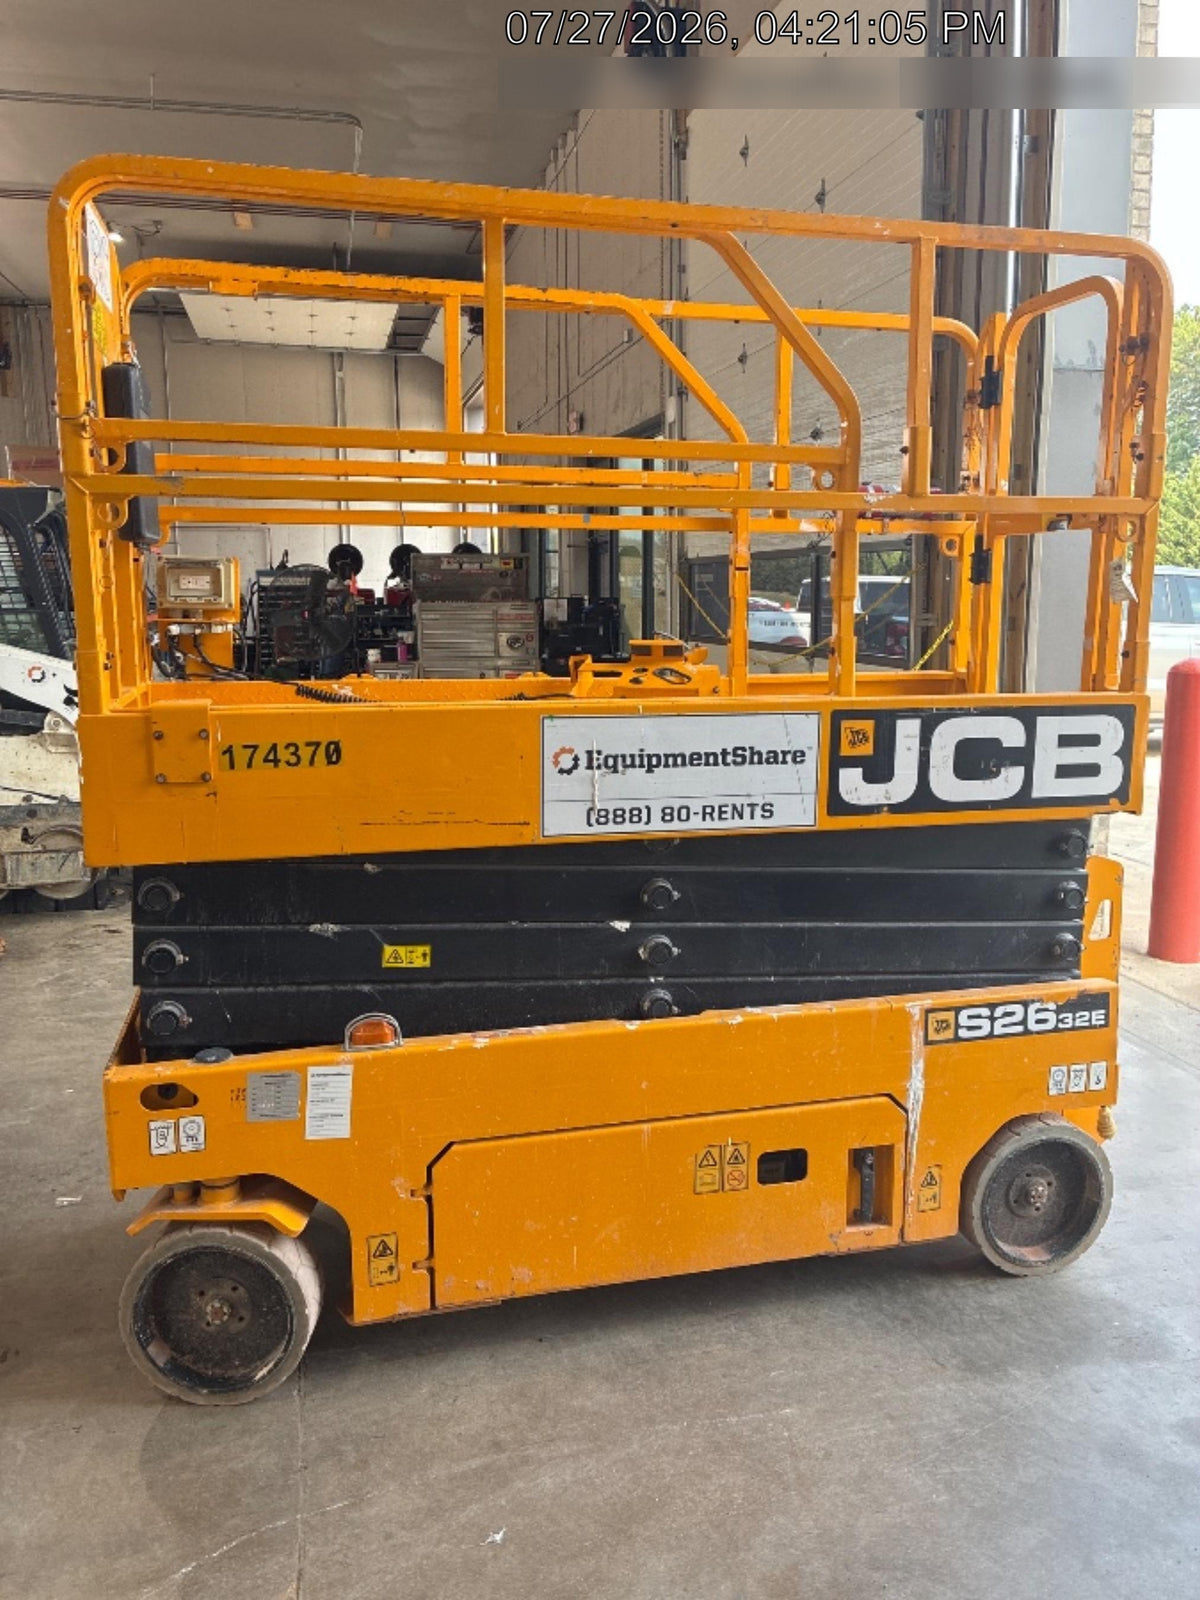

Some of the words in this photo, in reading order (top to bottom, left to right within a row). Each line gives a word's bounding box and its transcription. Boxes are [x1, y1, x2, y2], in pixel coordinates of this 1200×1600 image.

[221, 740, 342, 770] 174370
[585, 746, 806, 774] EquipmentShare
[839, 714, 1125, 805] JCB
[586, 805, 651, 827] (888)
[660, 803, 774, 824] 80-RENTS
